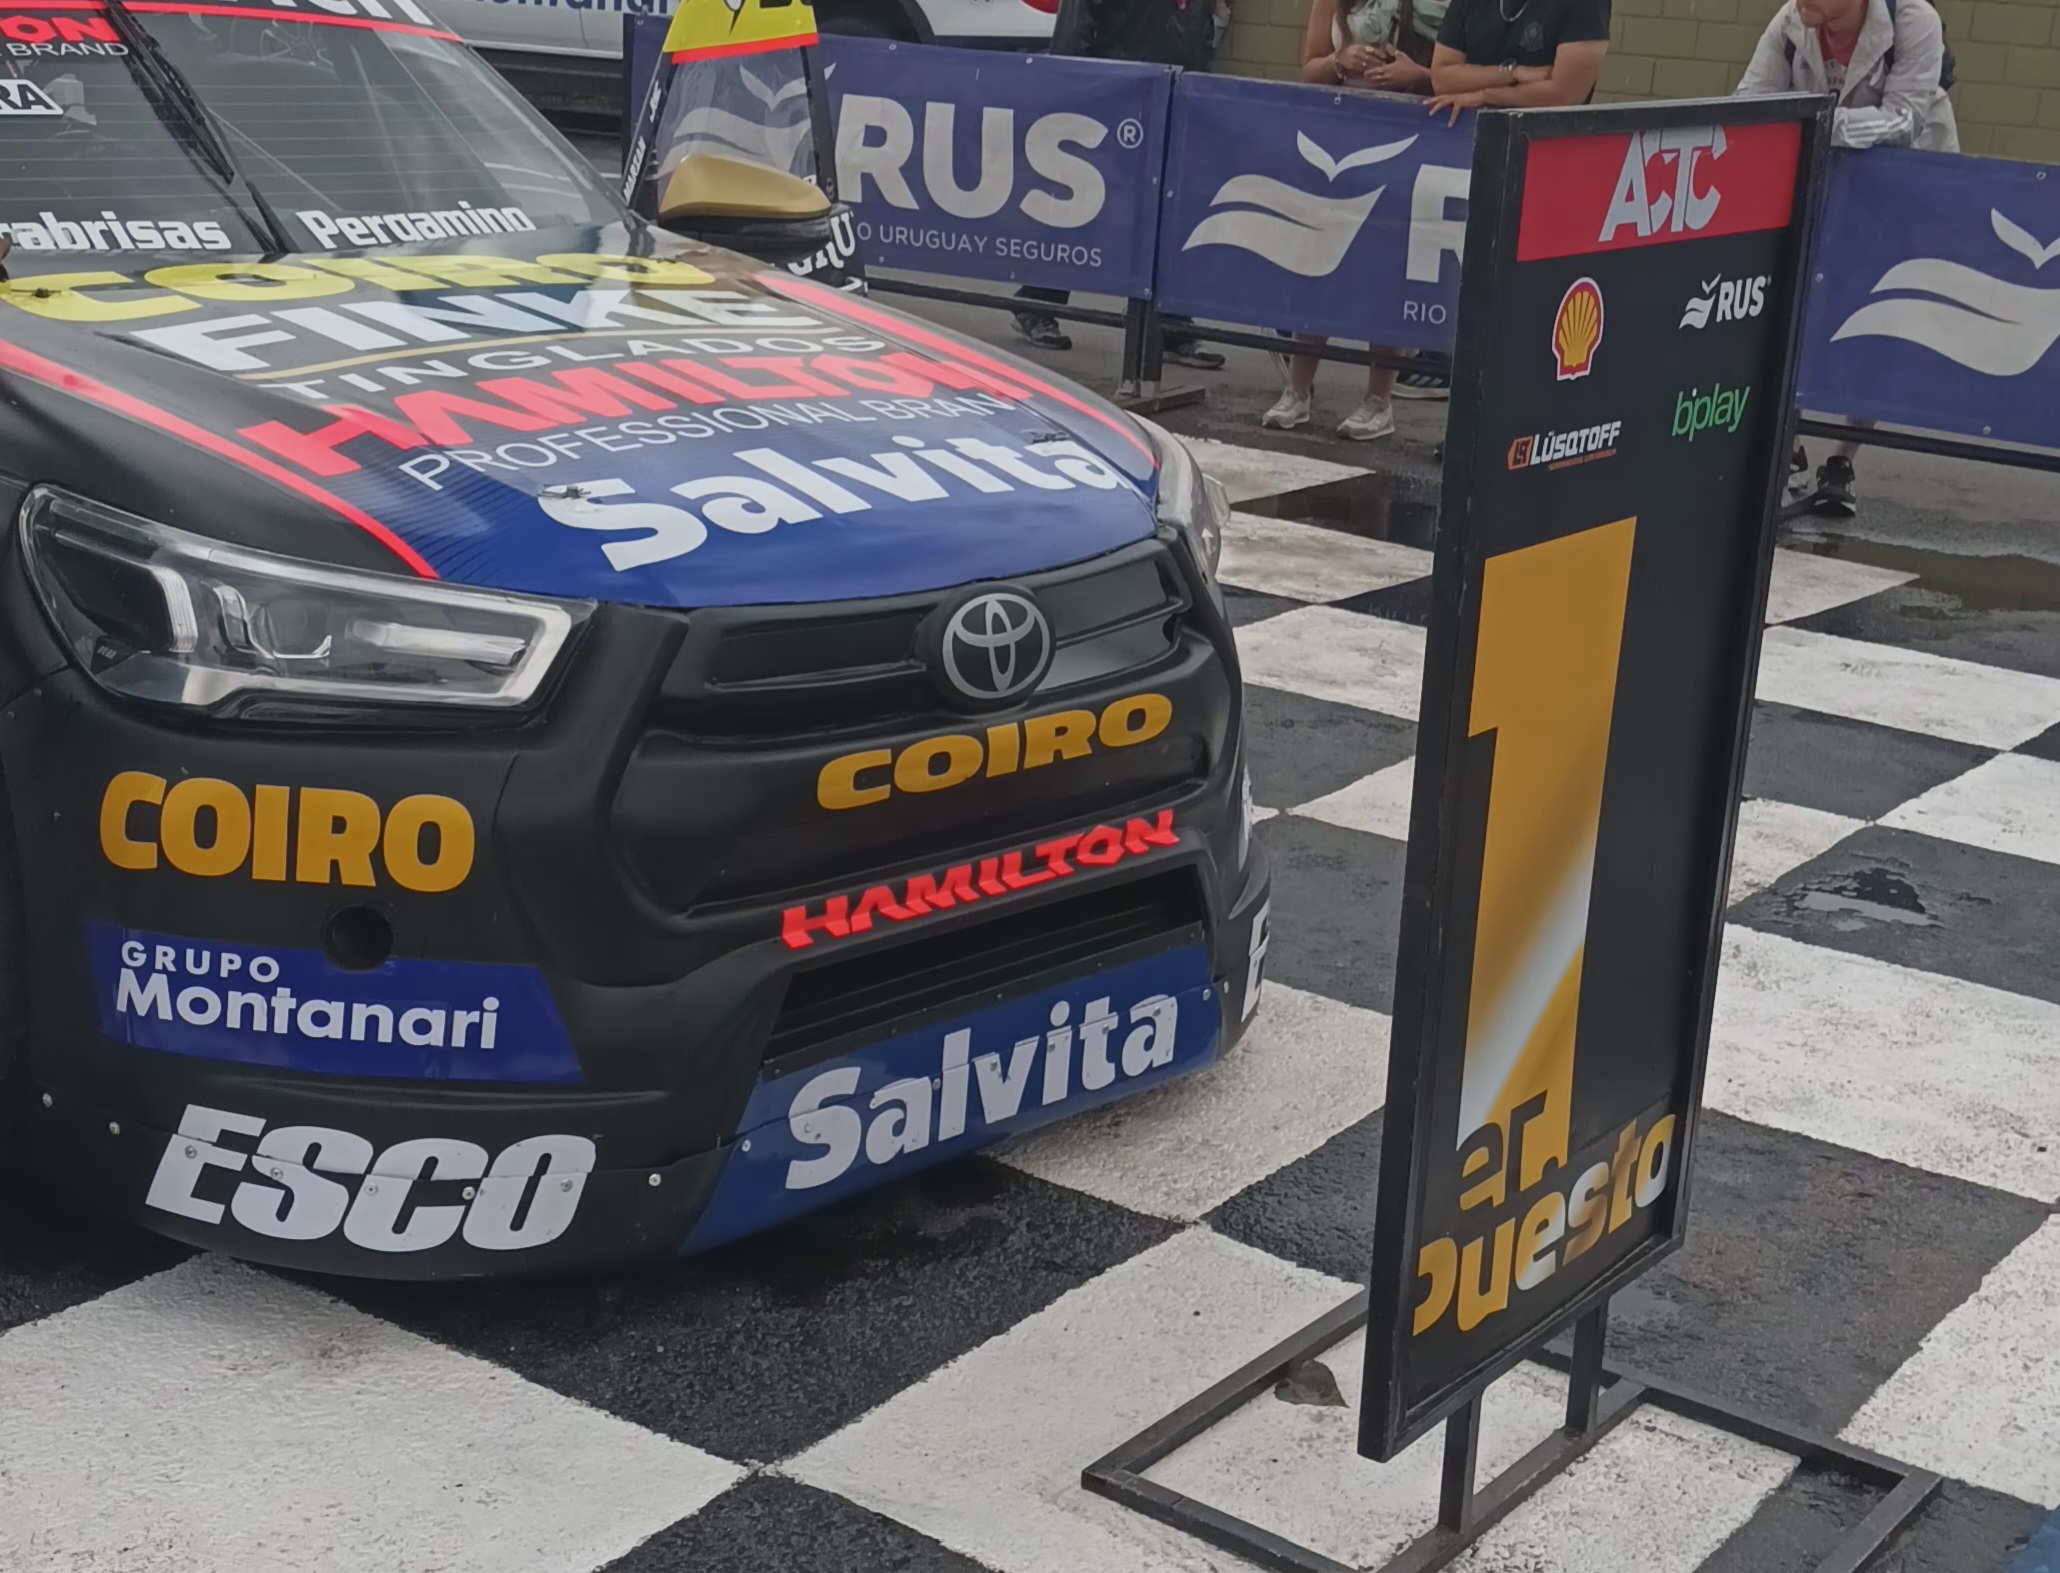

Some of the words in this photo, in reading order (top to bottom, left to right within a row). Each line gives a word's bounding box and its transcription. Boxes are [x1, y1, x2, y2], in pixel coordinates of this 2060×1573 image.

[6, 42, 129, 57] BRAND
[880, 225, 988, 255] URUGUAY
[995, 237, 1102, 268] SEGUROS
[130, 289, 822, 371] FINKE
[1403, 301, 1446, 324] RIO
[1716, 275, 1767, 323] RUS
[258, 335, 887, 399] TINGLADOS
[237, 351, 1033, 477] HAMILTON
[398, 399, 877, 491] PROFESSIONAL
[859, 392, 1016, 420] BRAN
[538, 434, 1131, 572] Salvita
[818, 692, 1173, 811] COIRO
[99, 770, 475, 893] COIRO
[781, 808, 1180, 950] HAMILTON
[120, 940, 281, 984] GRUPO
[115, 967, 501, 1050] Montanari
[785, 993, 1179, 1191] Salvita
[145, 1103, 597, 1253] ESCO
